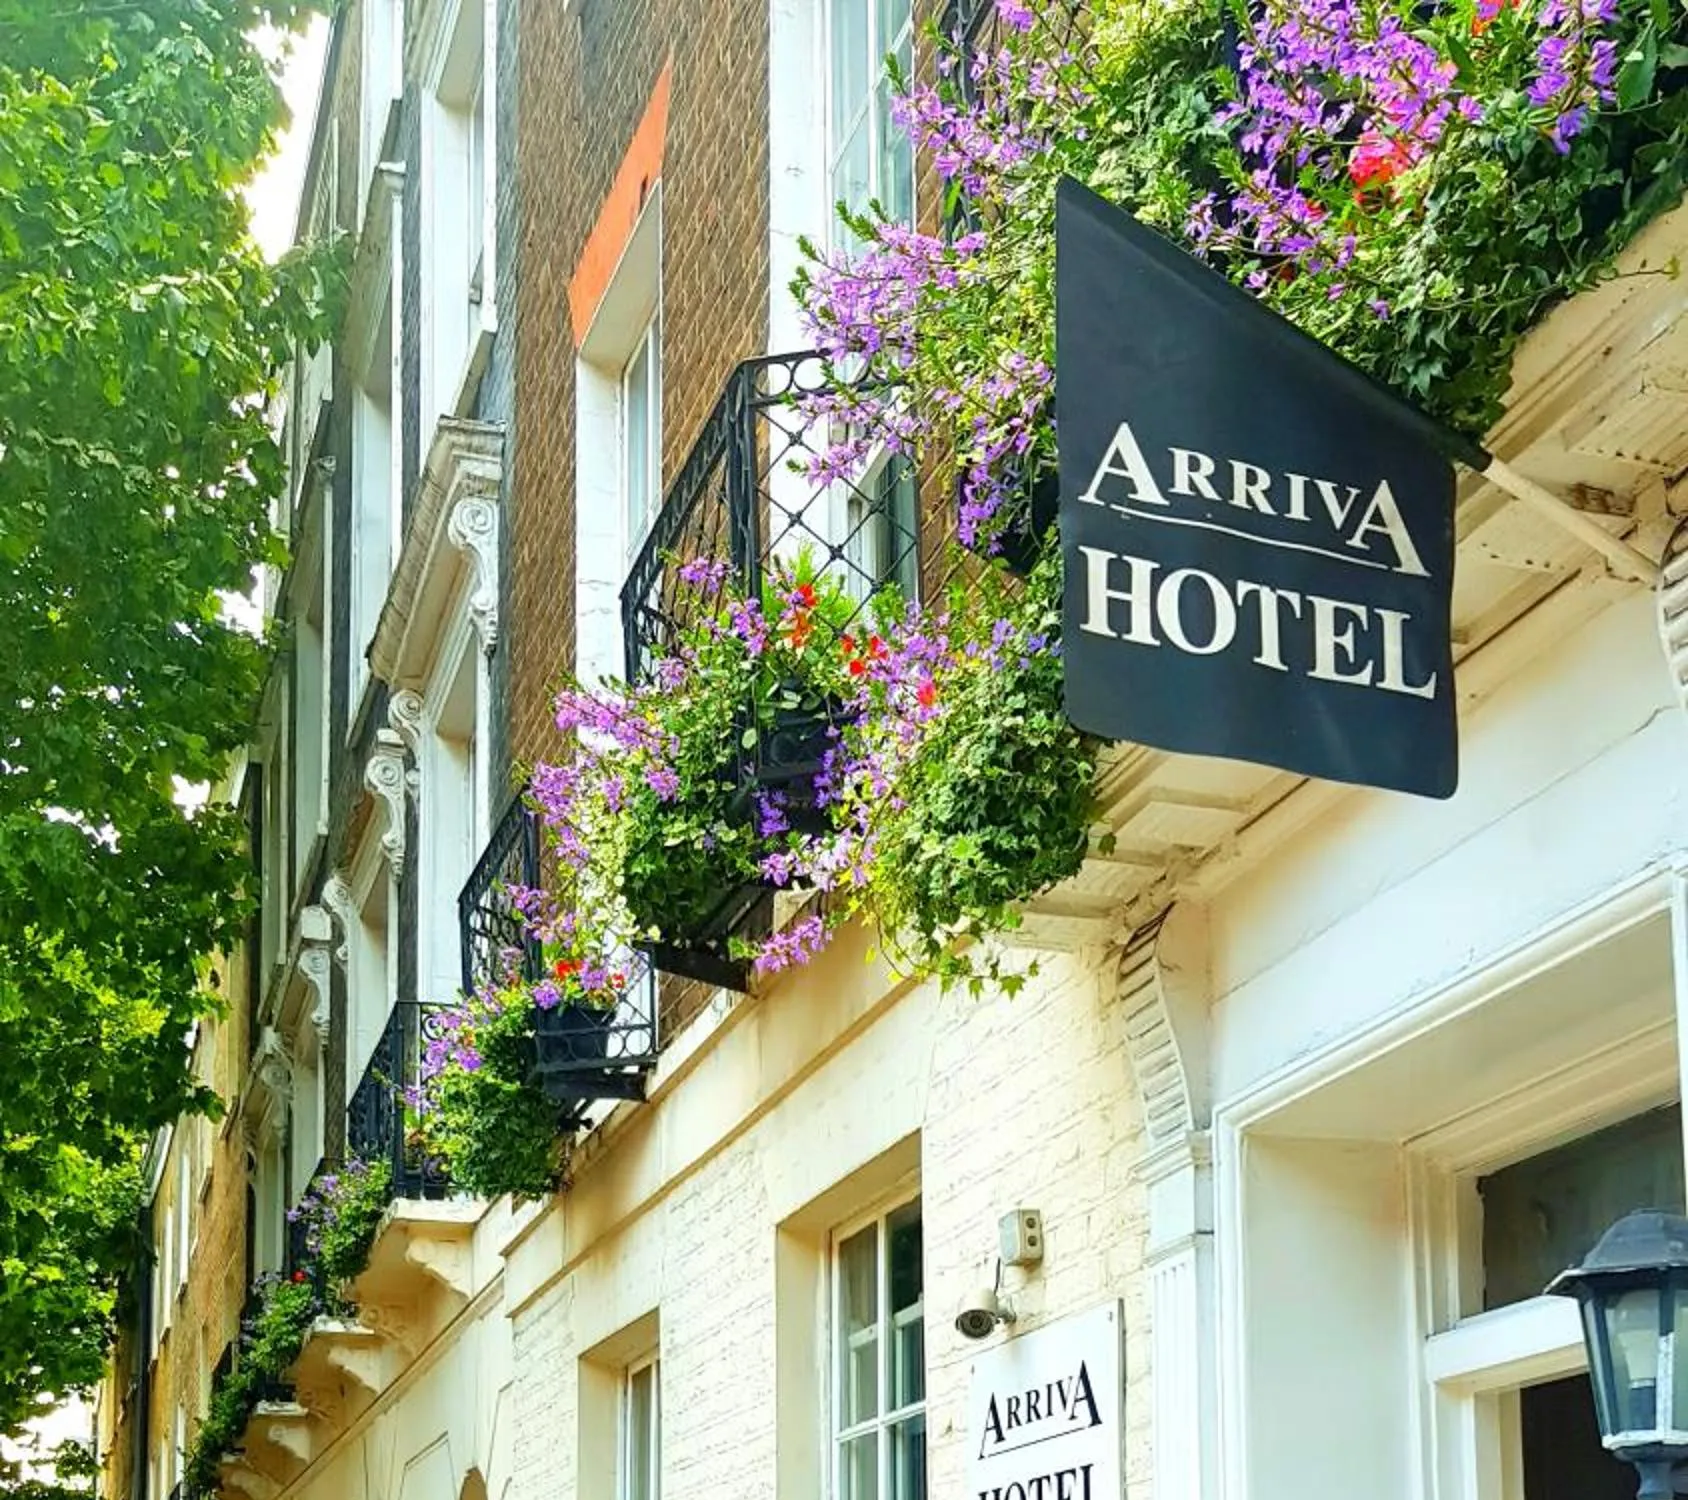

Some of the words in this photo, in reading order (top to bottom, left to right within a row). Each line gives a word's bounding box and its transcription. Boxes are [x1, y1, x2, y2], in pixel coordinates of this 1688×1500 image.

[1078, 421, 1432, 577] ARRIVA
[1078, 545, 1437, 700] HOTEL
[977, 1359, 1103, 1460] ARRIVA
